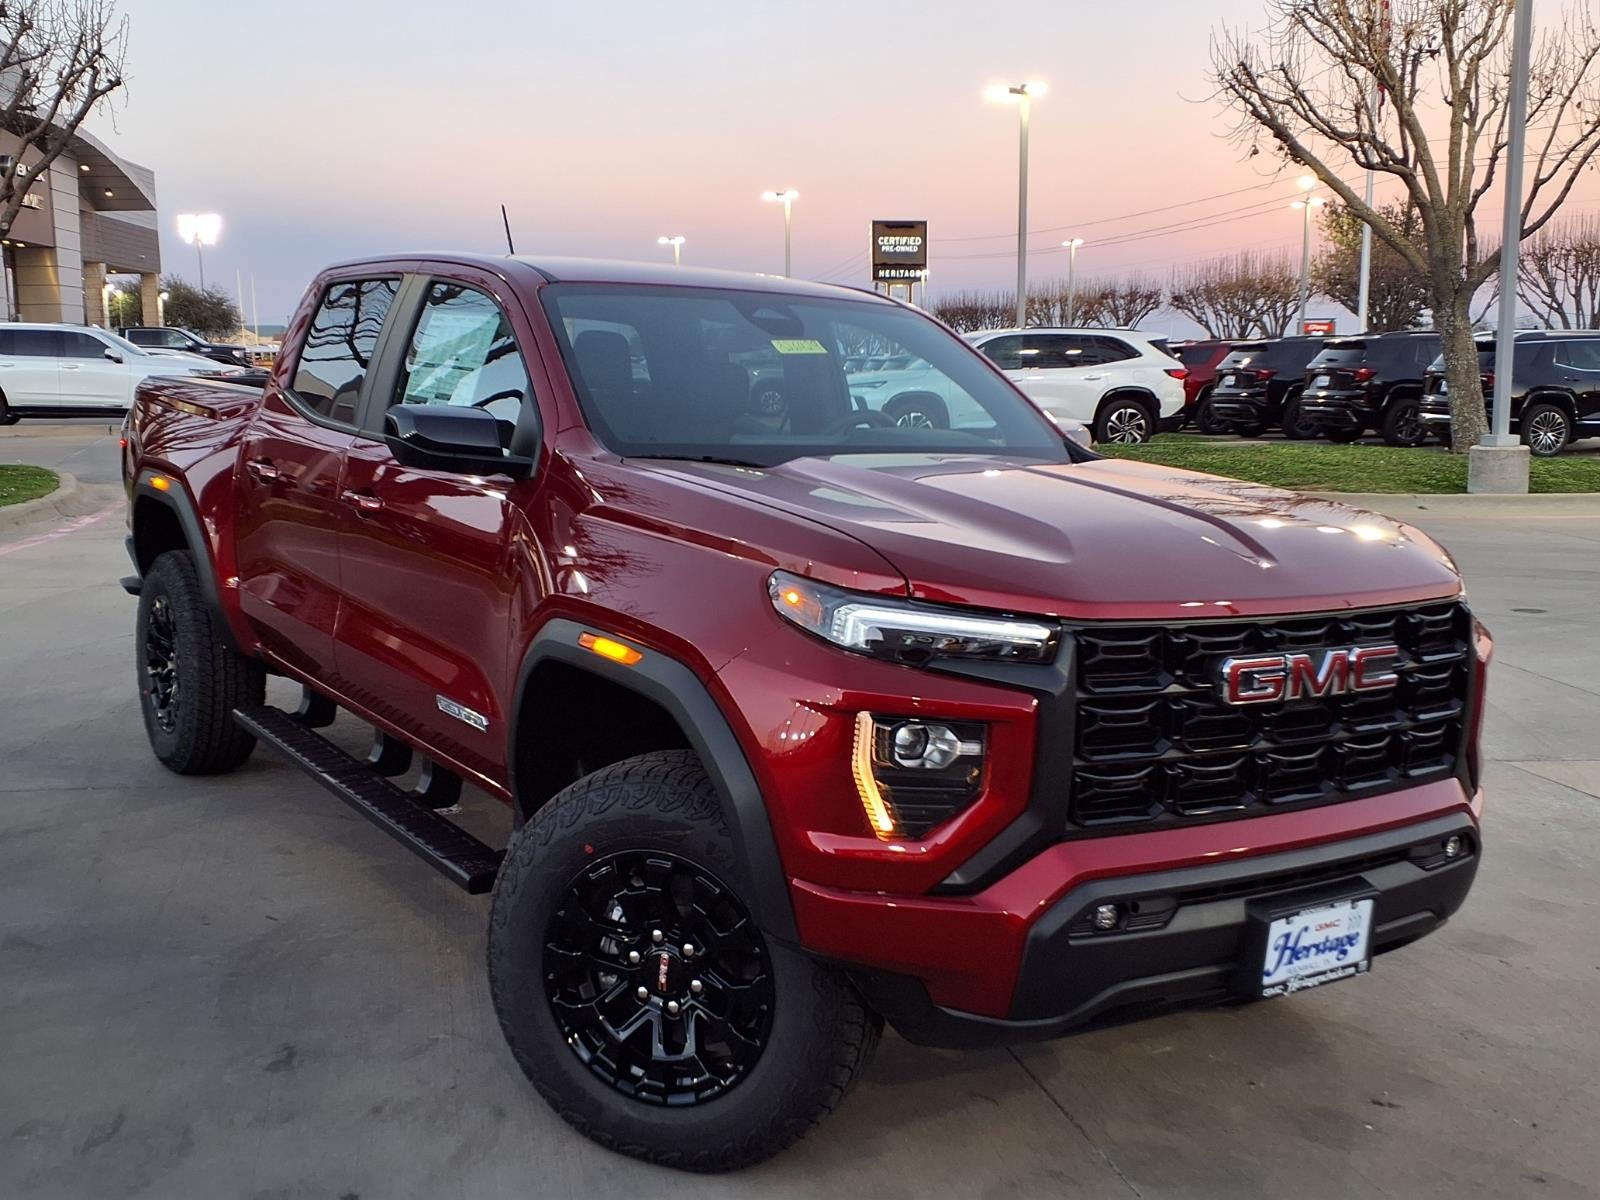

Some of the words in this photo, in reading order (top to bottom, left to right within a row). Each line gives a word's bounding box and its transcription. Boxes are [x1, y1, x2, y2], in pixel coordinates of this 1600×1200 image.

[878, 236, 922, 245] CERTIFIED
[1222, 645, 1399, 705] GMC
[1263, 926, 1360, 977] Heritage
